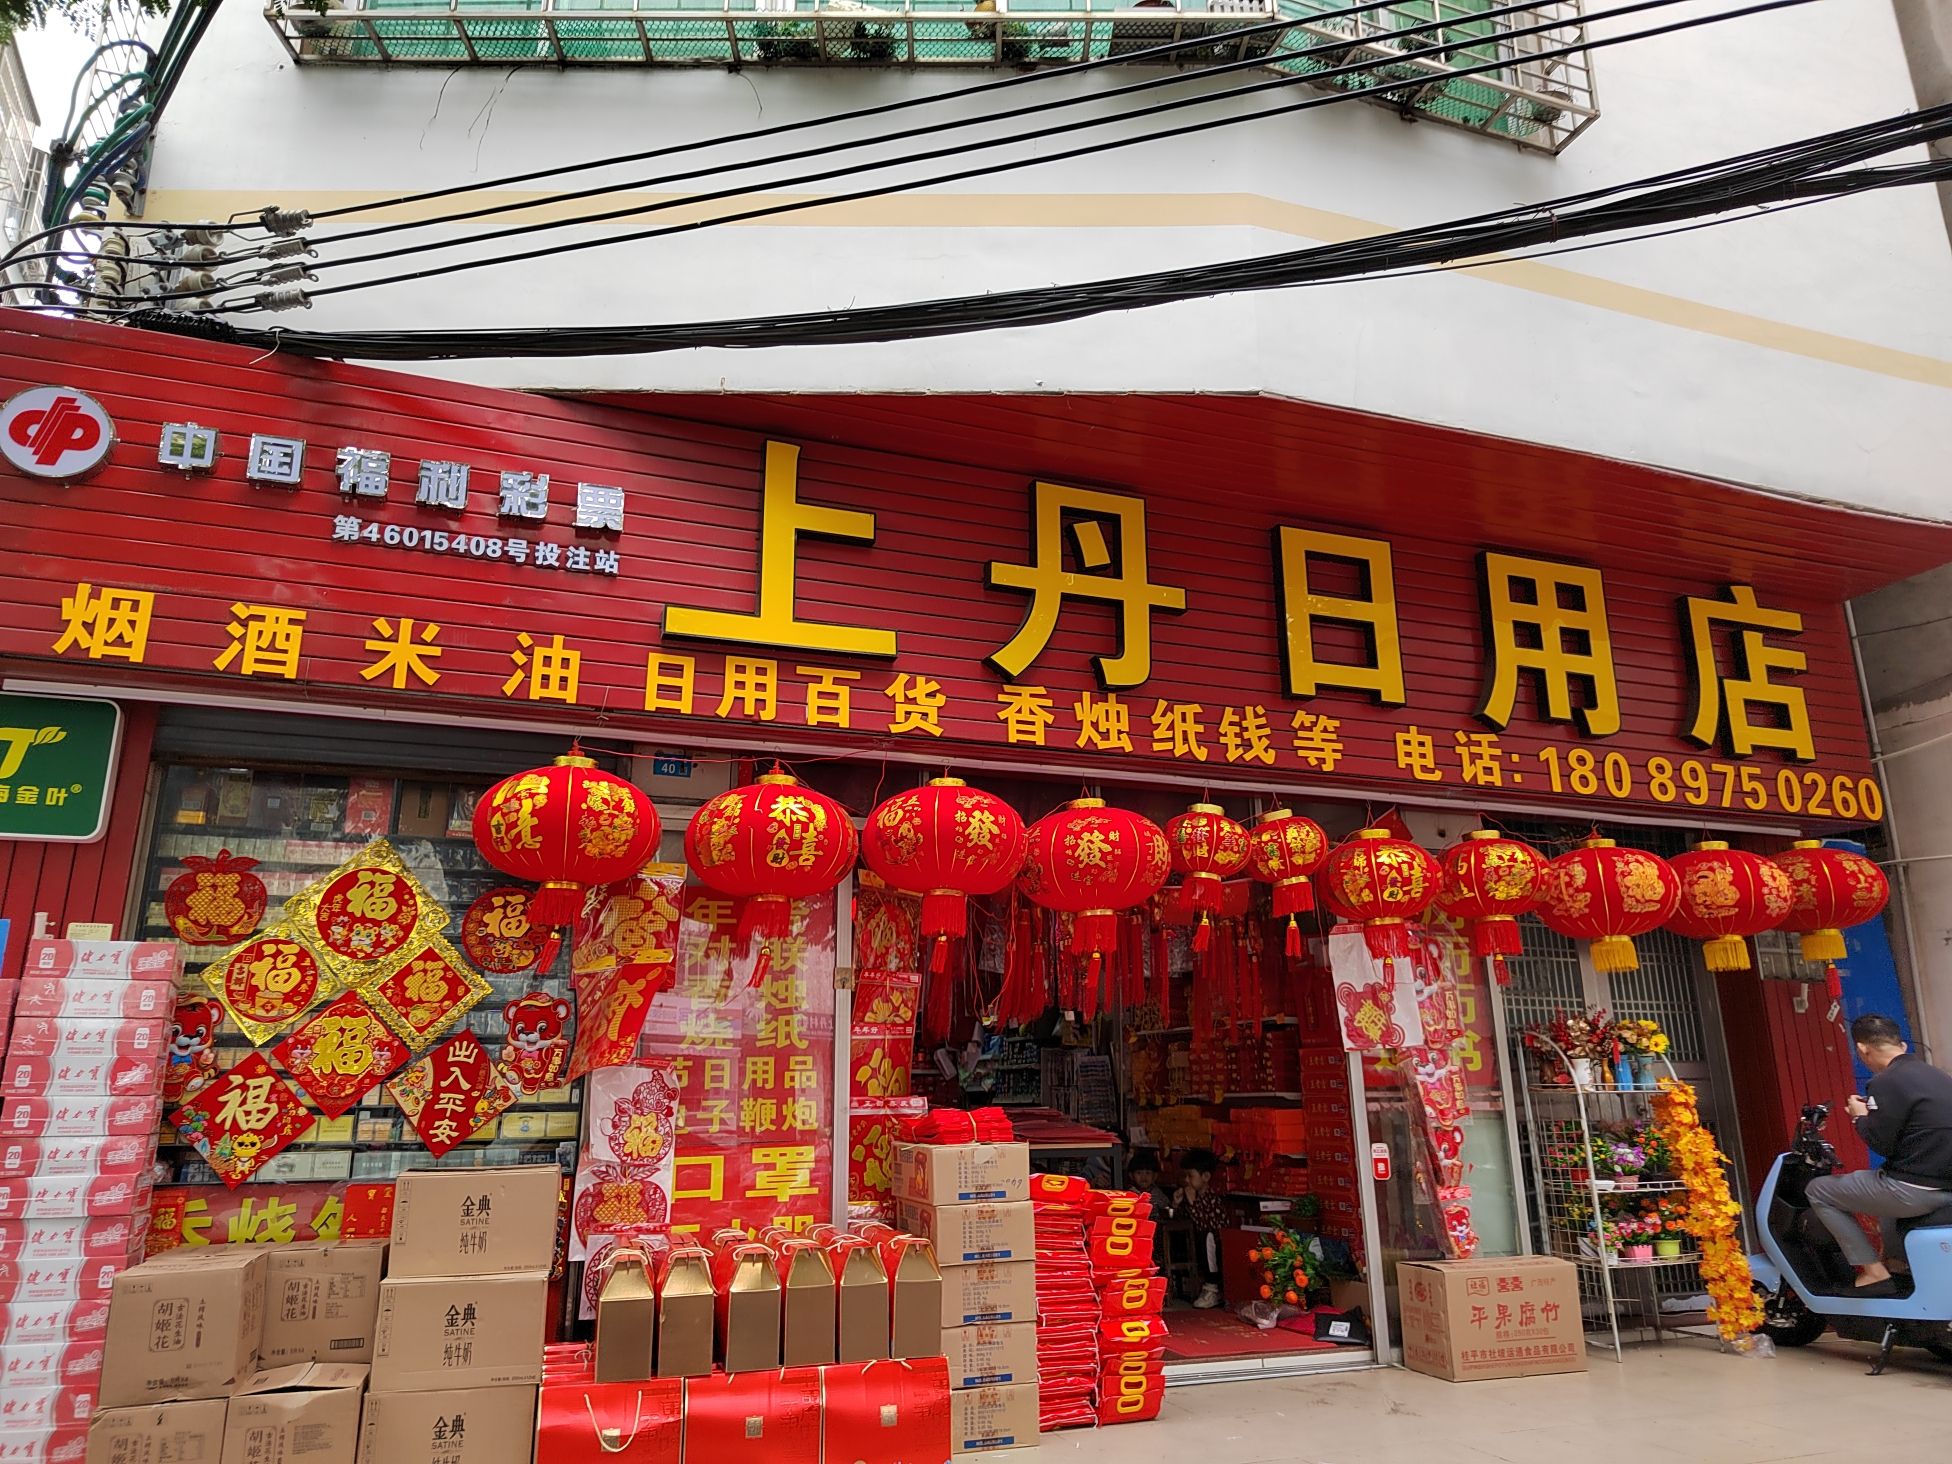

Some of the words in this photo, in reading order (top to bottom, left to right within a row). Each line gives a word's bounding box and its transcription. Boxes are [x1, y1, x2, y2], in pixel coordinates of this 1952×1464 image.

[157, 421, 625, 533] 中国福利彩票
[333, 514, 621, 576] 第46015408号投注站
[661, 440, 1816, 762] 上丹日用店
[52, 583, 581, 704] 烟酒米油
[643, 652, 947, 737] 日用百货
[997, 684, 1344, 773] 香烛纸钱等
[346, 870, 398, 920] 福
[482, 894, 530, 938] 福
[250, 943, 302, 993] 福
[403, 960, 449, 1003] 福
[312, 1015, 374, 1076] 福
[680, 1011, 809, 1050] 烧纸
[429, 1040, 479, 1145] 出入平安
[666, 1056, 817, 1090] 节日用品
[214, 1074, 279, 1131] 福
[623, 1112, 665, 1159] 福
[672, 1146, 819, 1204] 口罩
[153, 1207, 178, 1231] 福
[460, 1194, 492, 1218] 金典
[460, 1217, 490, 1226] SATINE
[458, 1231, 488, 1254] 纯牛奶
[154, 1302, 173, 1349] 胡姬花
[443, 1327, 476, 1336] SATINE
[444, 1303, 477, 1328] 金典
[1470, 1301, 1560, 1330] 平果腐竹
[442, 1342, 473, 1367] 纯牛奶
[431, 1440, 464, 1450] SATINE
[432, 1414, 465, 1441] 金典
